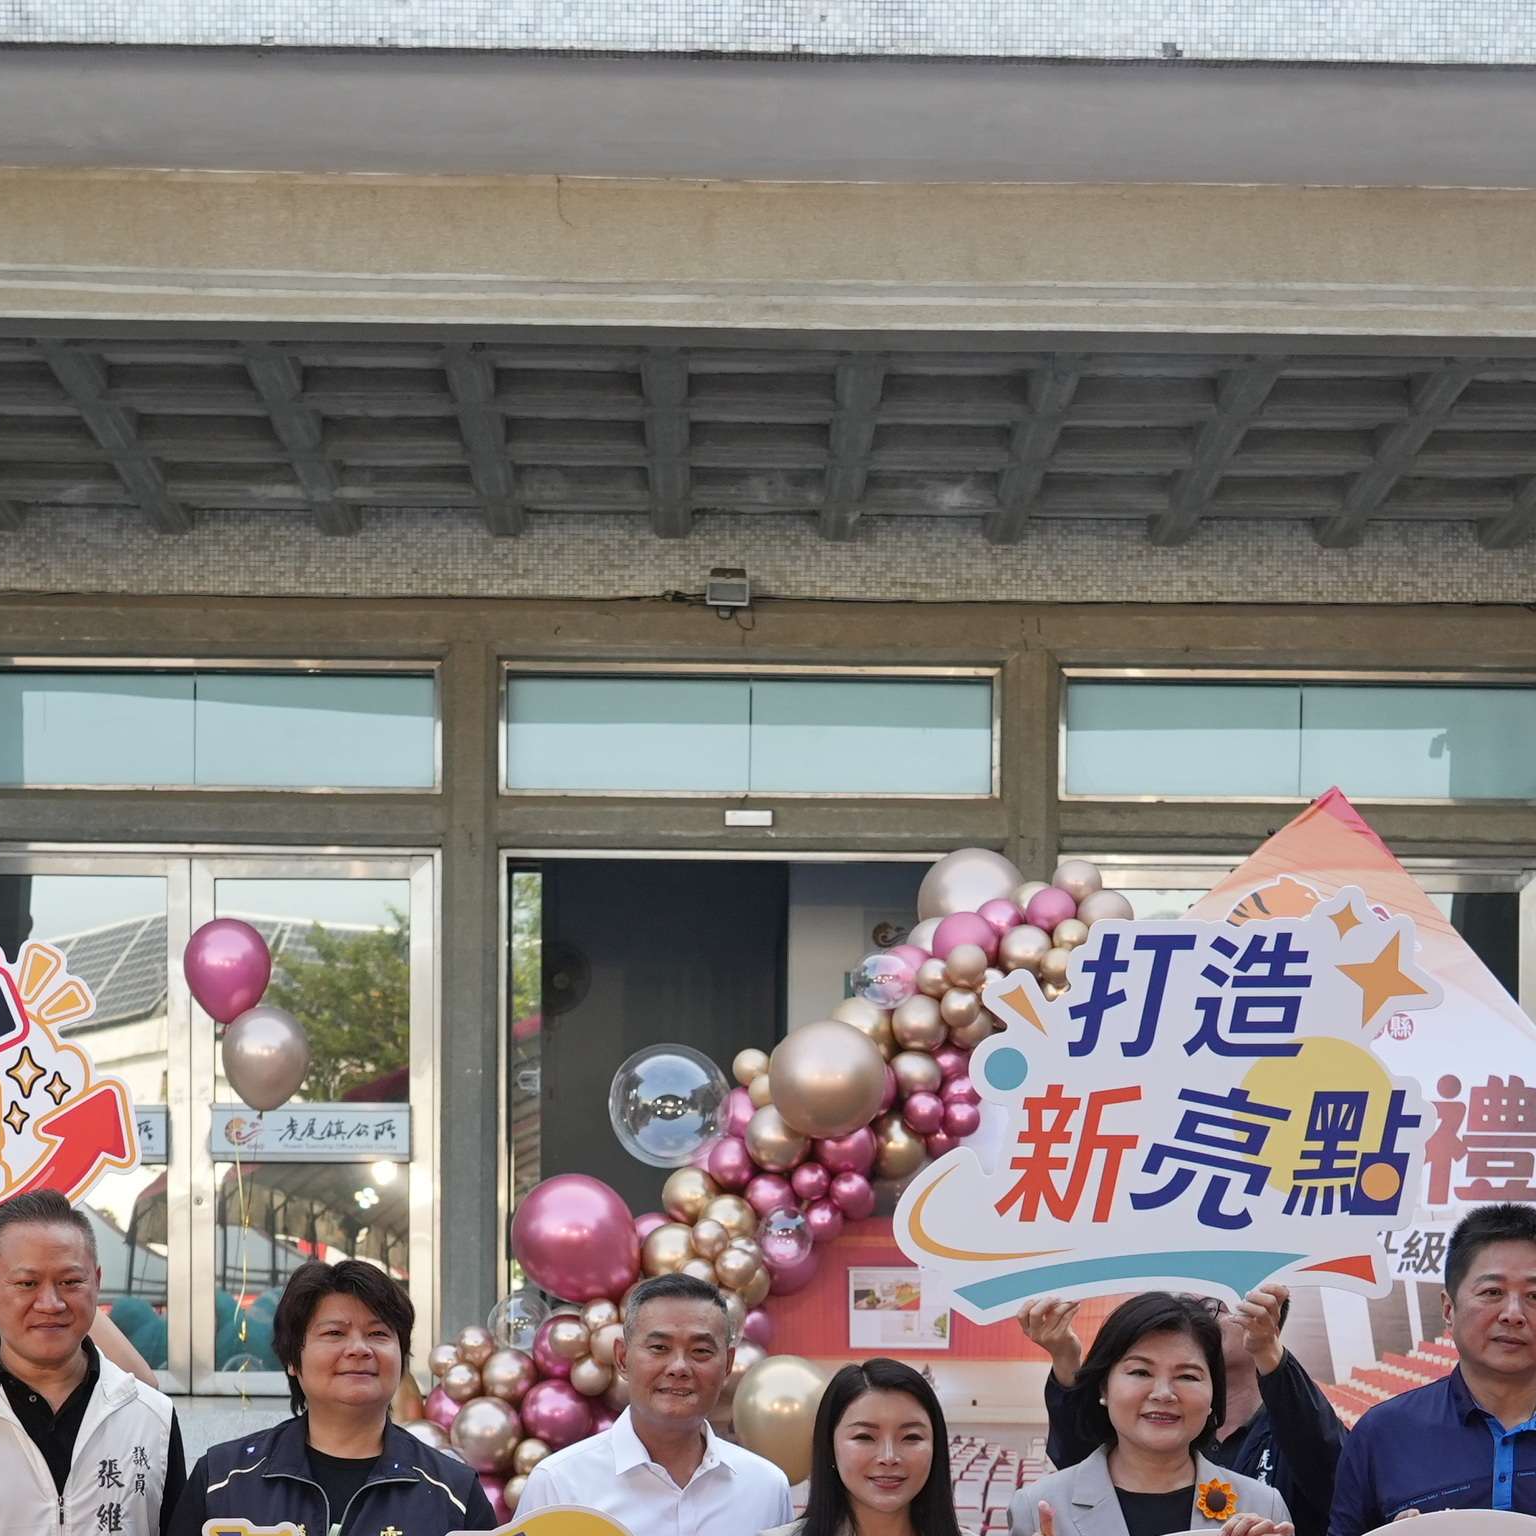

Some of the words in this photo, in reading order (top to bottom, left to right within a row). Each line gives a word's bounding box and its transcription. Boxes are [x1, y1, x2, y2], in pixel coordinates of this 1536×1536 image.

[1067, 933, 1314, 1059] 打造
[995, 1083, 1423, 1231] 新亮點
[132, 1446, 151, 1497] 議員
